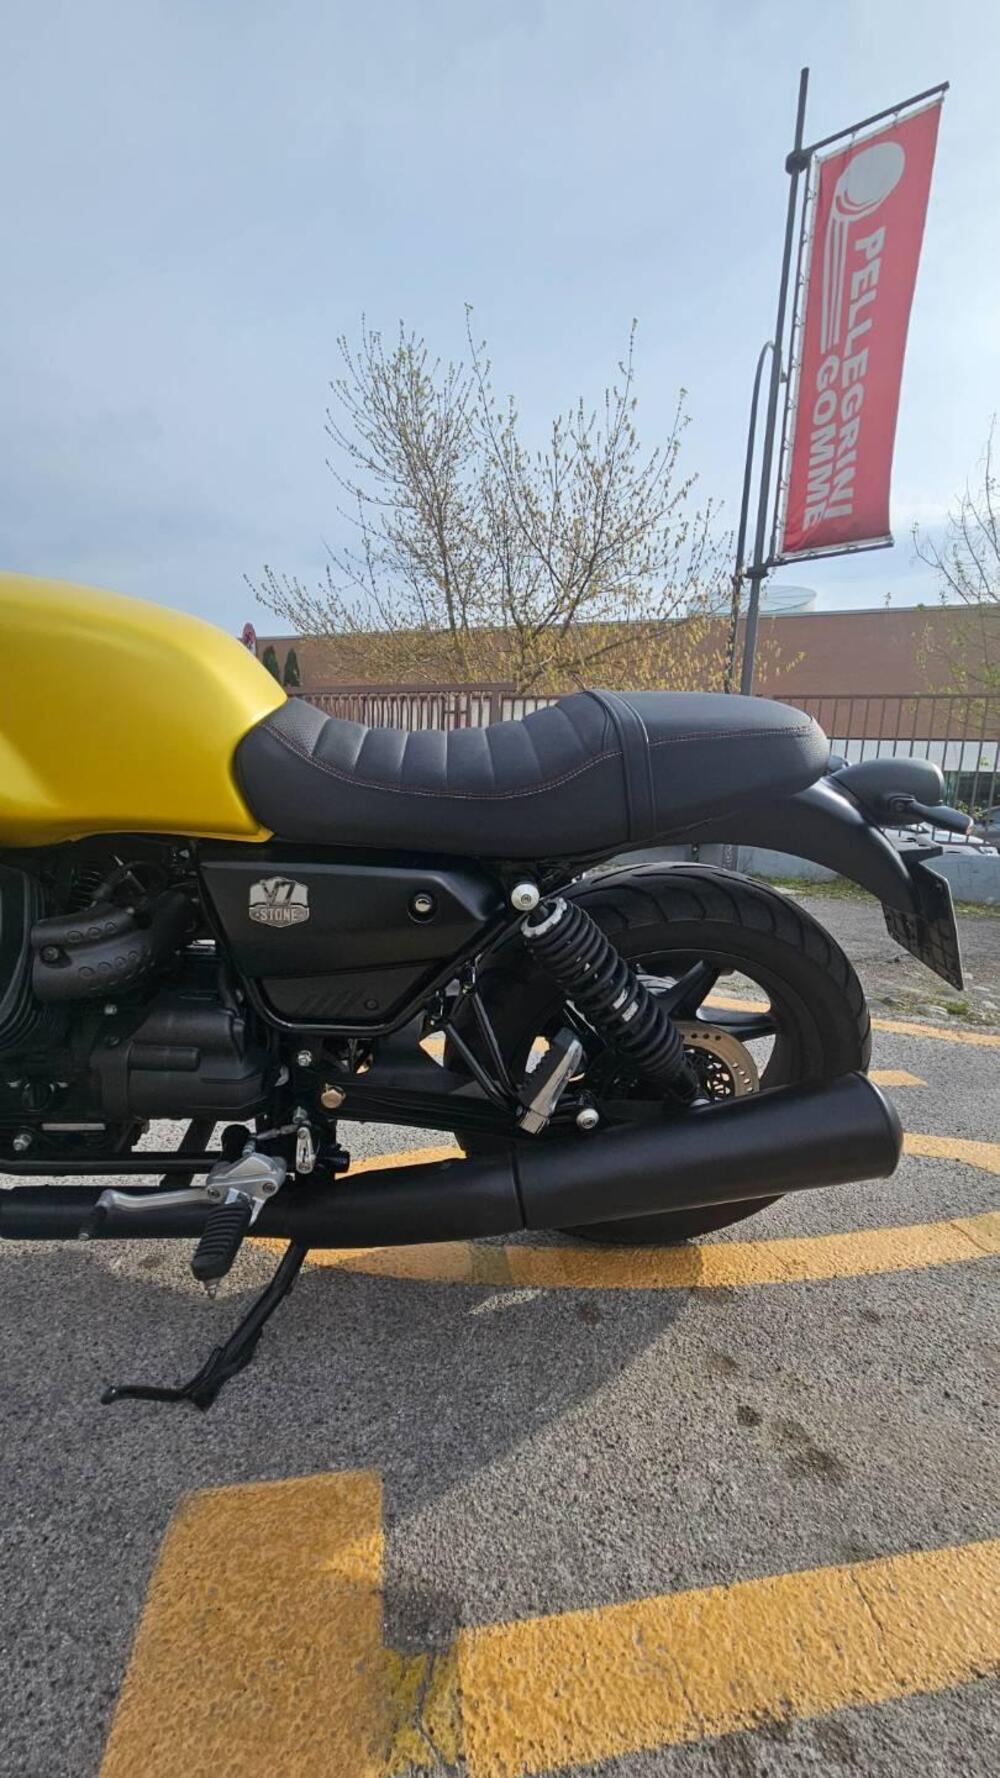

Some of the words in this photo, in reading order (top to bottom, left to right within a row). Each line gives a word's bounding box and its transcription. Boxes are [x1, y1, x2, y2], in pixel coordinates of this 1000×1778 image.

[826, 225, 886, 519] PELLEGRINI
[803, 354, 841, 532] GOMME
[259, 907, 298, 921] STONE
[261, 880, 296, 906] V7
